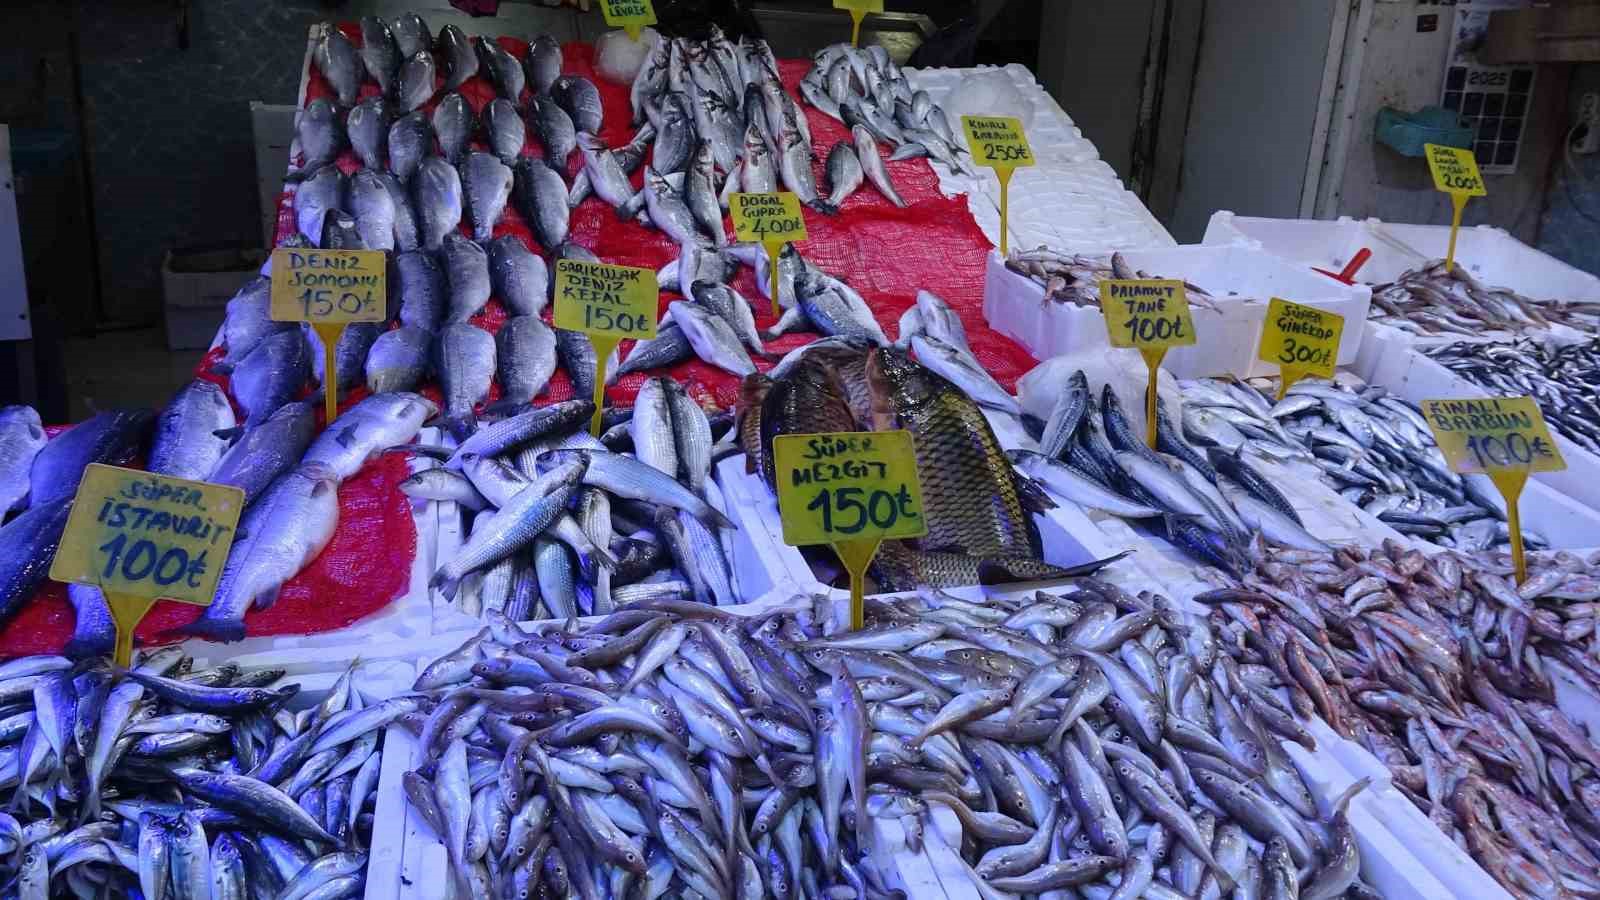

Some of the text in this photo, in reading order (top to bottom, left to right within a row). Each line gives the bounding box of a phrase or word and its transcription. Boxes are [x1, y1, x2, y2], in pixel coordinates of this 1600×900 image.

[1470, 71, 1507, 85] 2025
[562, 286, 631, 306] KEFAL
[1111, 284, 1175, 298] PALAMUT
[1124, 298, 1167, 314] TANE
[1431, 409, 1534, 432] BARBUN
